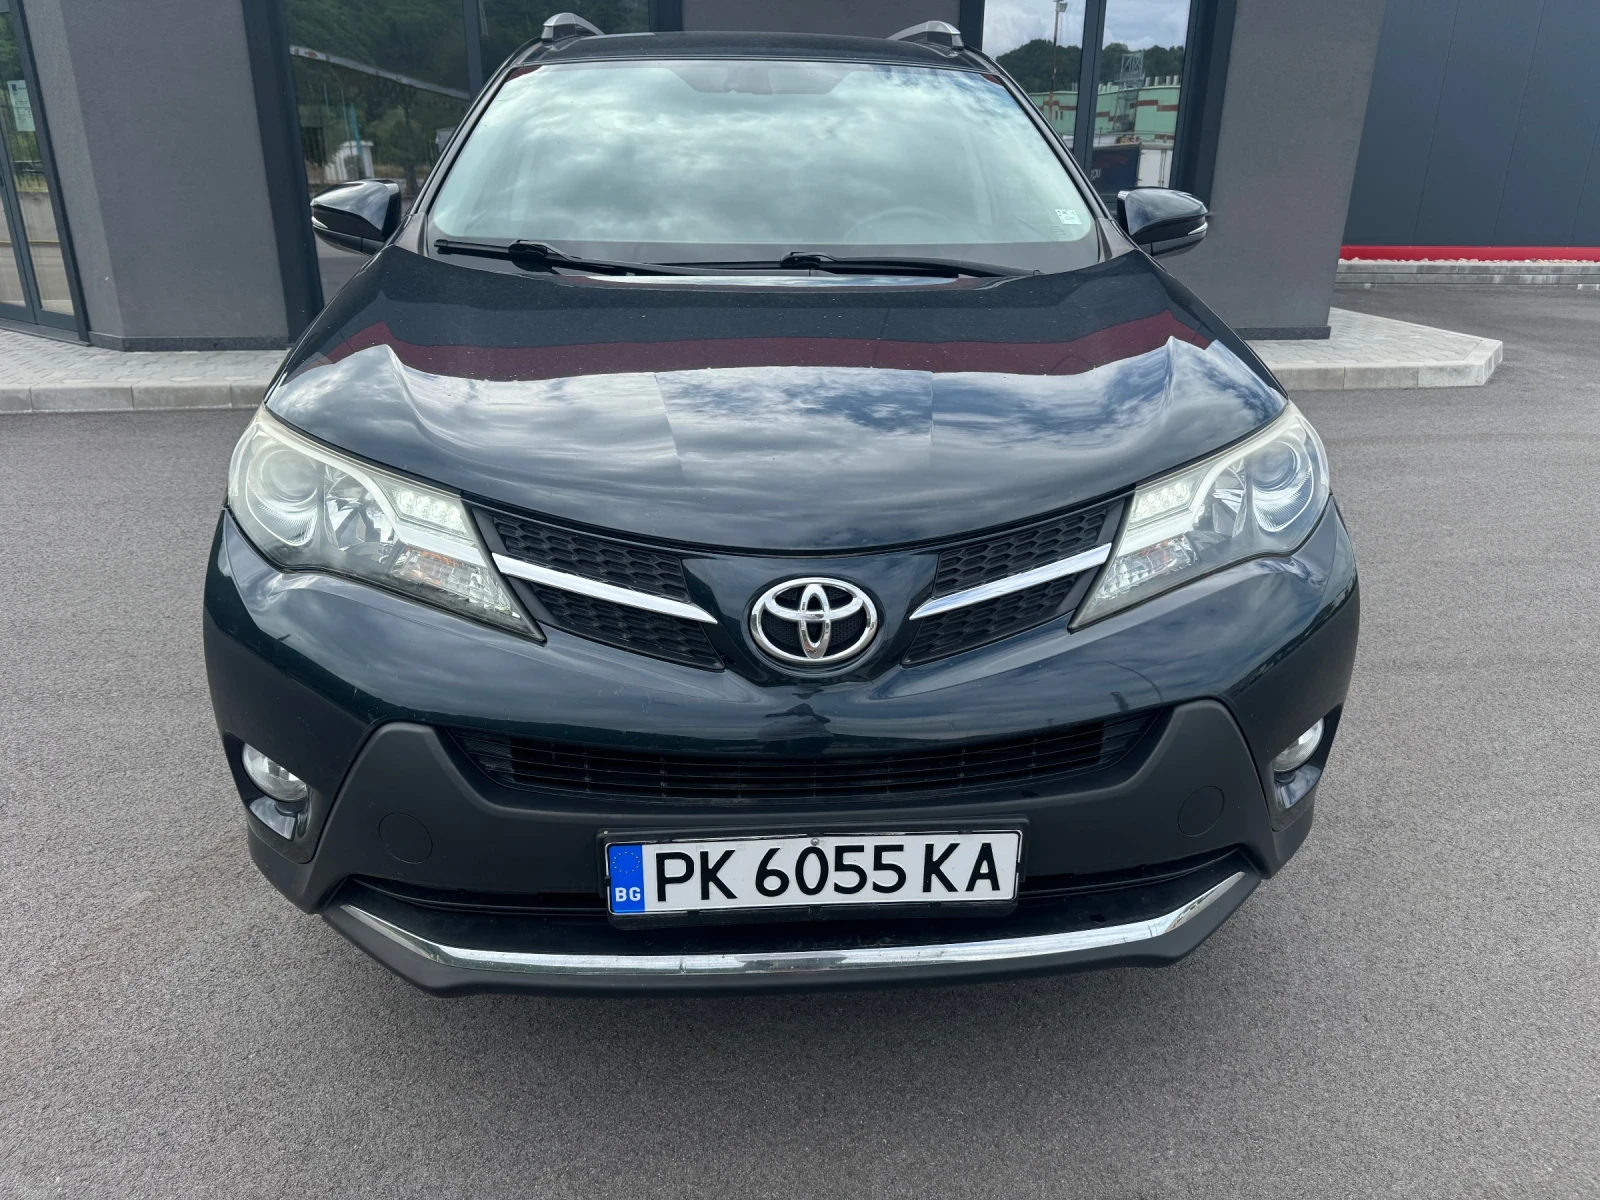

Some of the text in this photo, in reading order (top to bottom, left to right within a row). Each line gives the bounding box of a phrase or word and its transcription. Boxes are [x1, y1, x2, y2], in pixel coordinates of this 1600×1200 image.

[655, 842, 1001, 903] PK 6055 KA
[615, 886, 641, 902] BG
